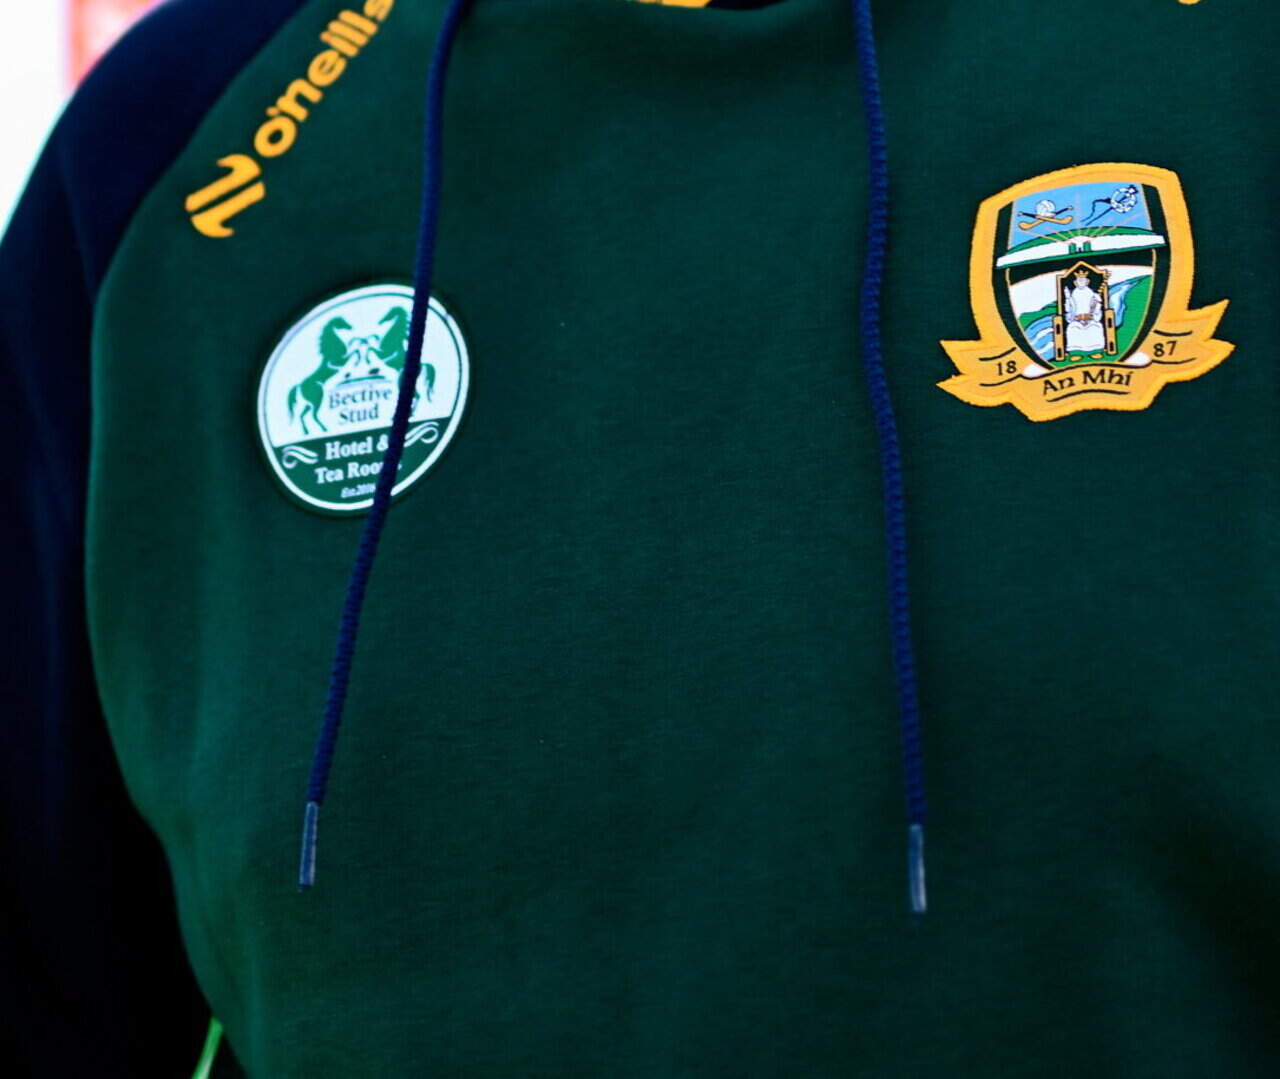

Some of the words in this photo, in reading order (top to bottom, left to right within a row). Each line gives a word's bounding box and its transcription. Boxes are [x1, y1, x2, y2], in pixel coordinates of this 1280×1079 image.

[1153, 340, 1178, 358] 87
[997, 360, 1018, 376] 18
[1042, 376, 1076, 396] An
[328, 386, 393, 409] Bective
[339, 403, 380, 425] Stud
[325, 435, 373, 461] Hotel
[314, 465, 344, 484] Tea
